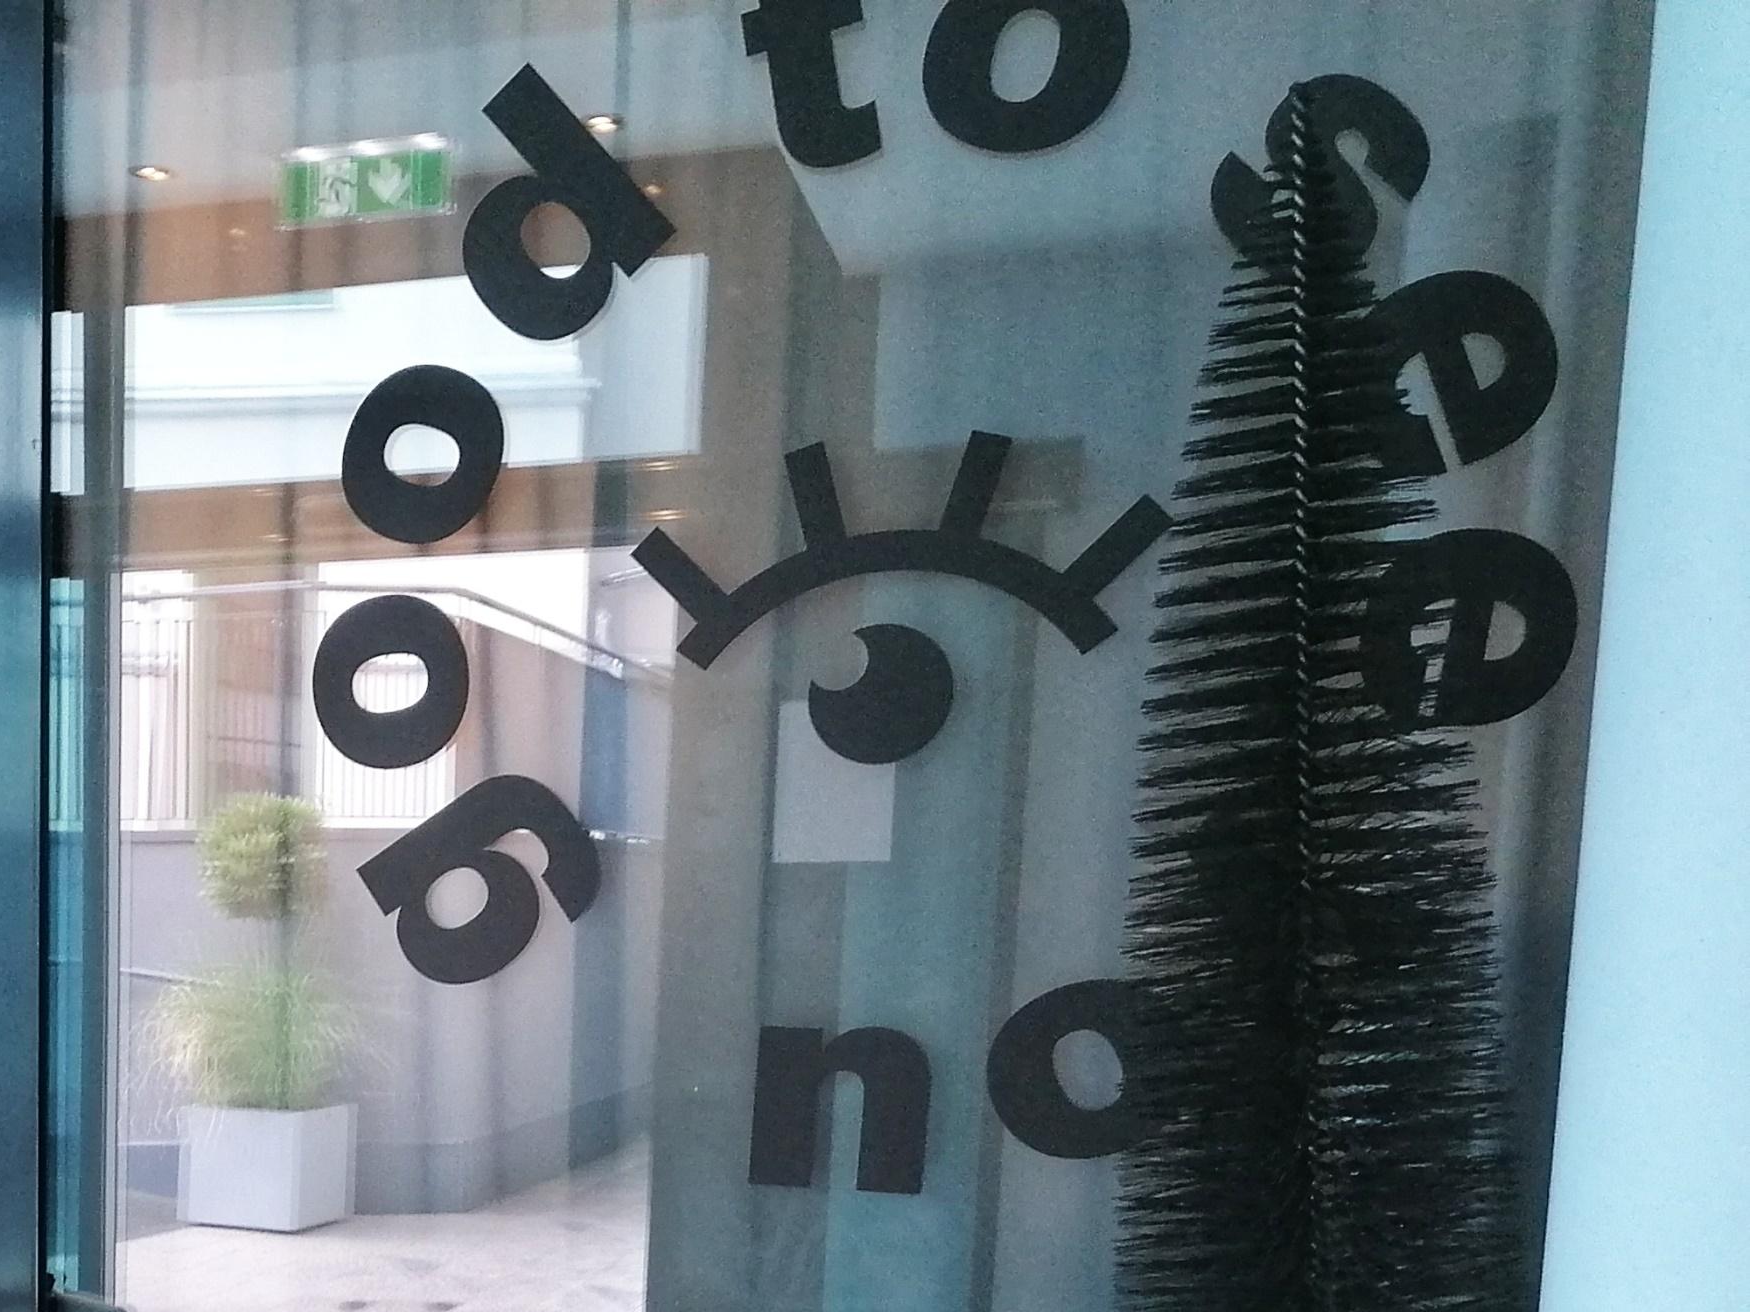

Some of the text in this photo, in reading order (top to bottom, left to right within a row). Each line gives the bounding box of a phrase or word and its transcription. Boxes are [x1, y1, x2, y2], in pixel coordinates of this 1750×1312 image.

[312, 63, 677, 985] good
[741, 0, 1132, 169] to
[1211, 73, 1578, 729] see
